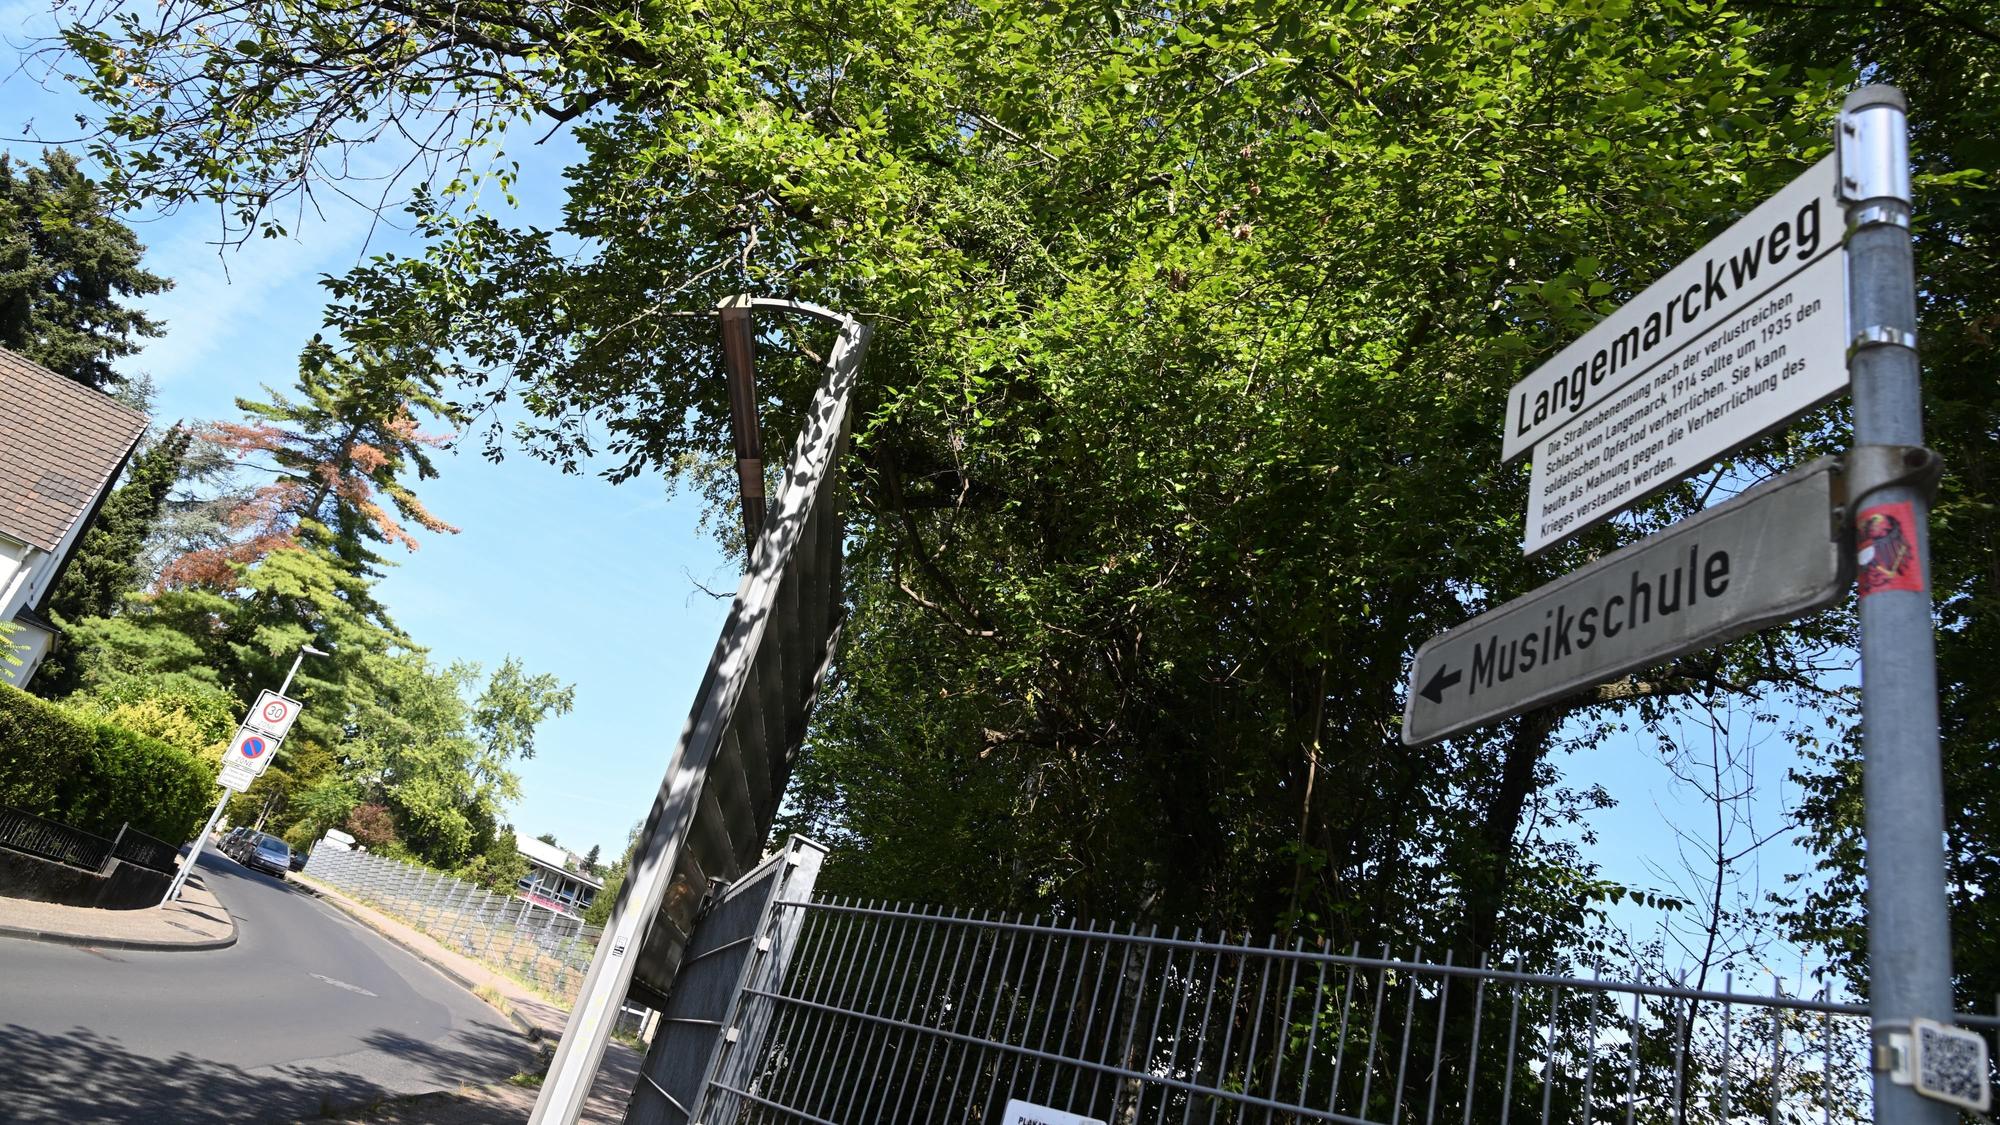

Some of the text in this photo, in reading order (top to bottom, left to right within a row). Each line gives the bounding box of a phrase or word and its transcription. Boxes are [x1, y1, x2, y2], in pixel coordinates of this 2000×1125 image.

[1517, 197, 1821, 438] Langemarckweg
[1545, 298, 1821, 476] Schlacht von Langemarck 1914 sollte um 1935 den
[1547, 292, 1793, 456] Die Straßenbenennung nach der verlustreichen
[1540, 456, 1677, 538] Krieges verstanden werden.
[1542, 357, 1806, 518] heute als Mahnung gegen die Verherrlichung des
[1544, 344, 1787, 497] soldatischen Opfertod verherrlichen. Sie kann
[1468, 543, 1731, 696] Musikschule
[234, 755, 254, 767] ZONE
[267, 705, 283, 719] 30
